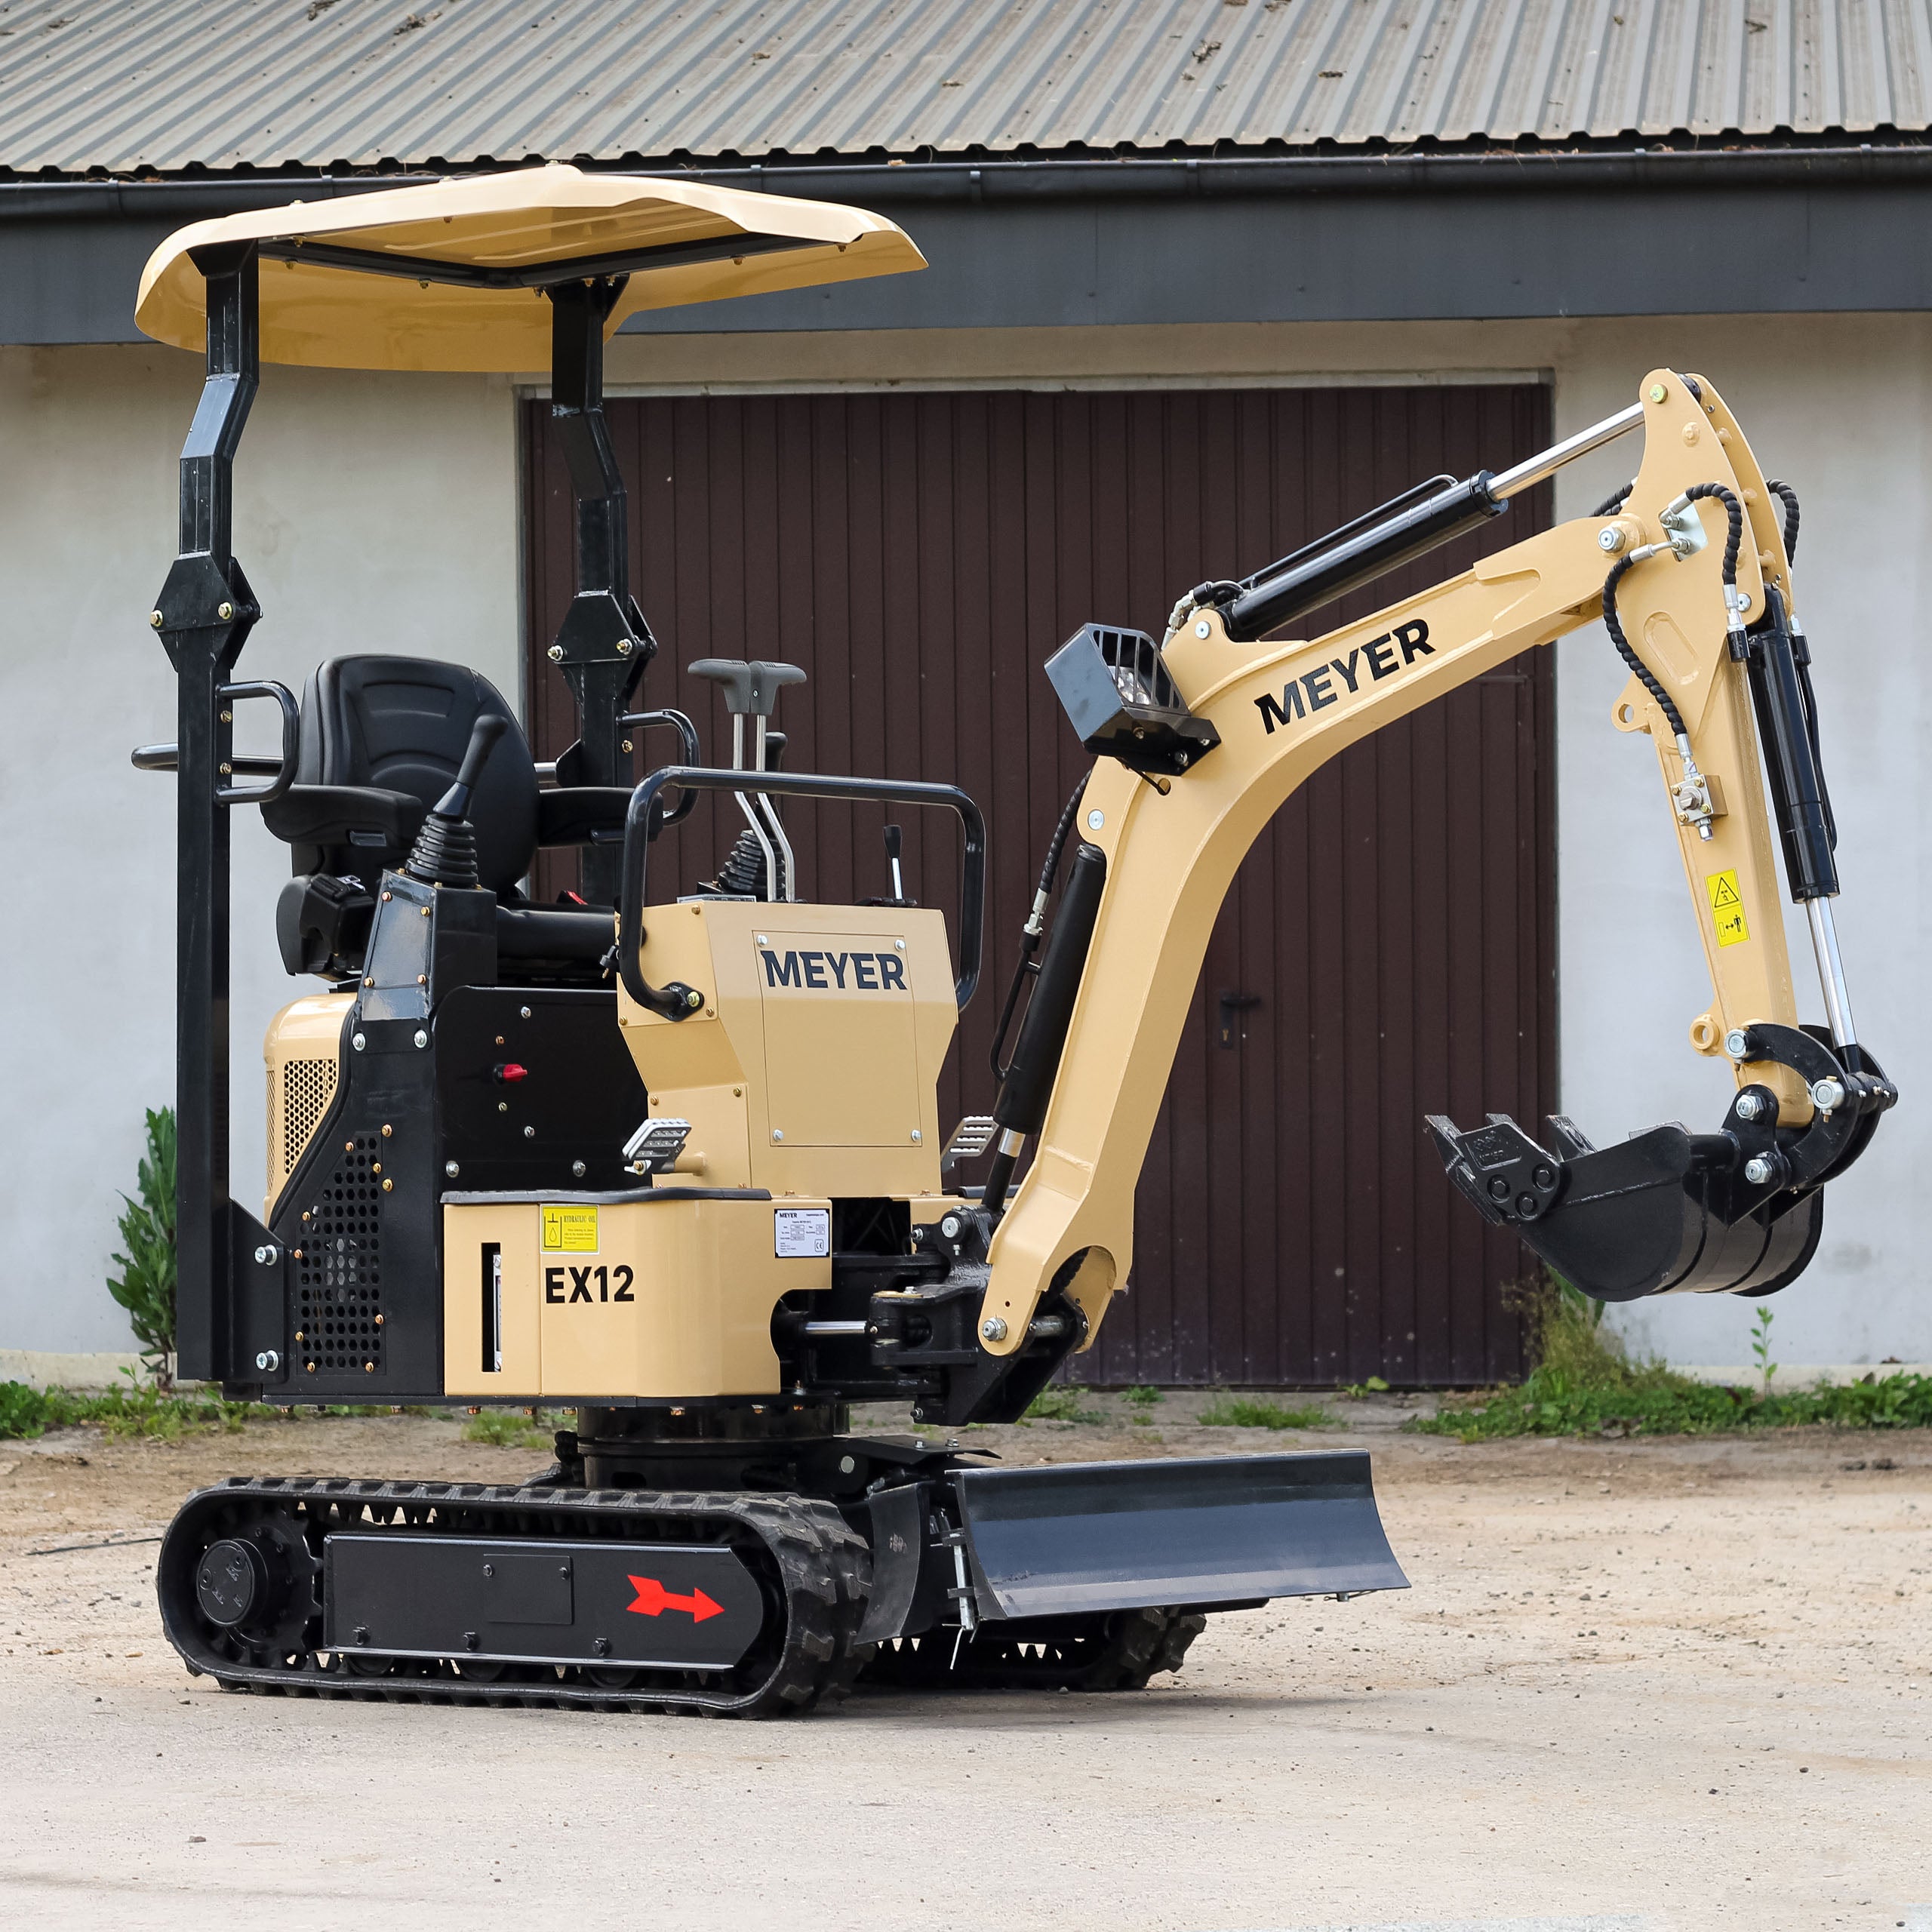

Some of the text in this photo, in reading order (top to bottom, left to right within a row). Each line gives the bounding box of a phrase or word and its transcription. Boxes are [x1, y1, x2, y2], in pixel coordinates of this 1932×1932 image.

[1254, 619, 1436, 735] MEYER
[760, 950, 907, 990] MEYER
[564, 1215, 586, 1223] HYDRAULIC
[545, 1265, 635, 1303] EX12
